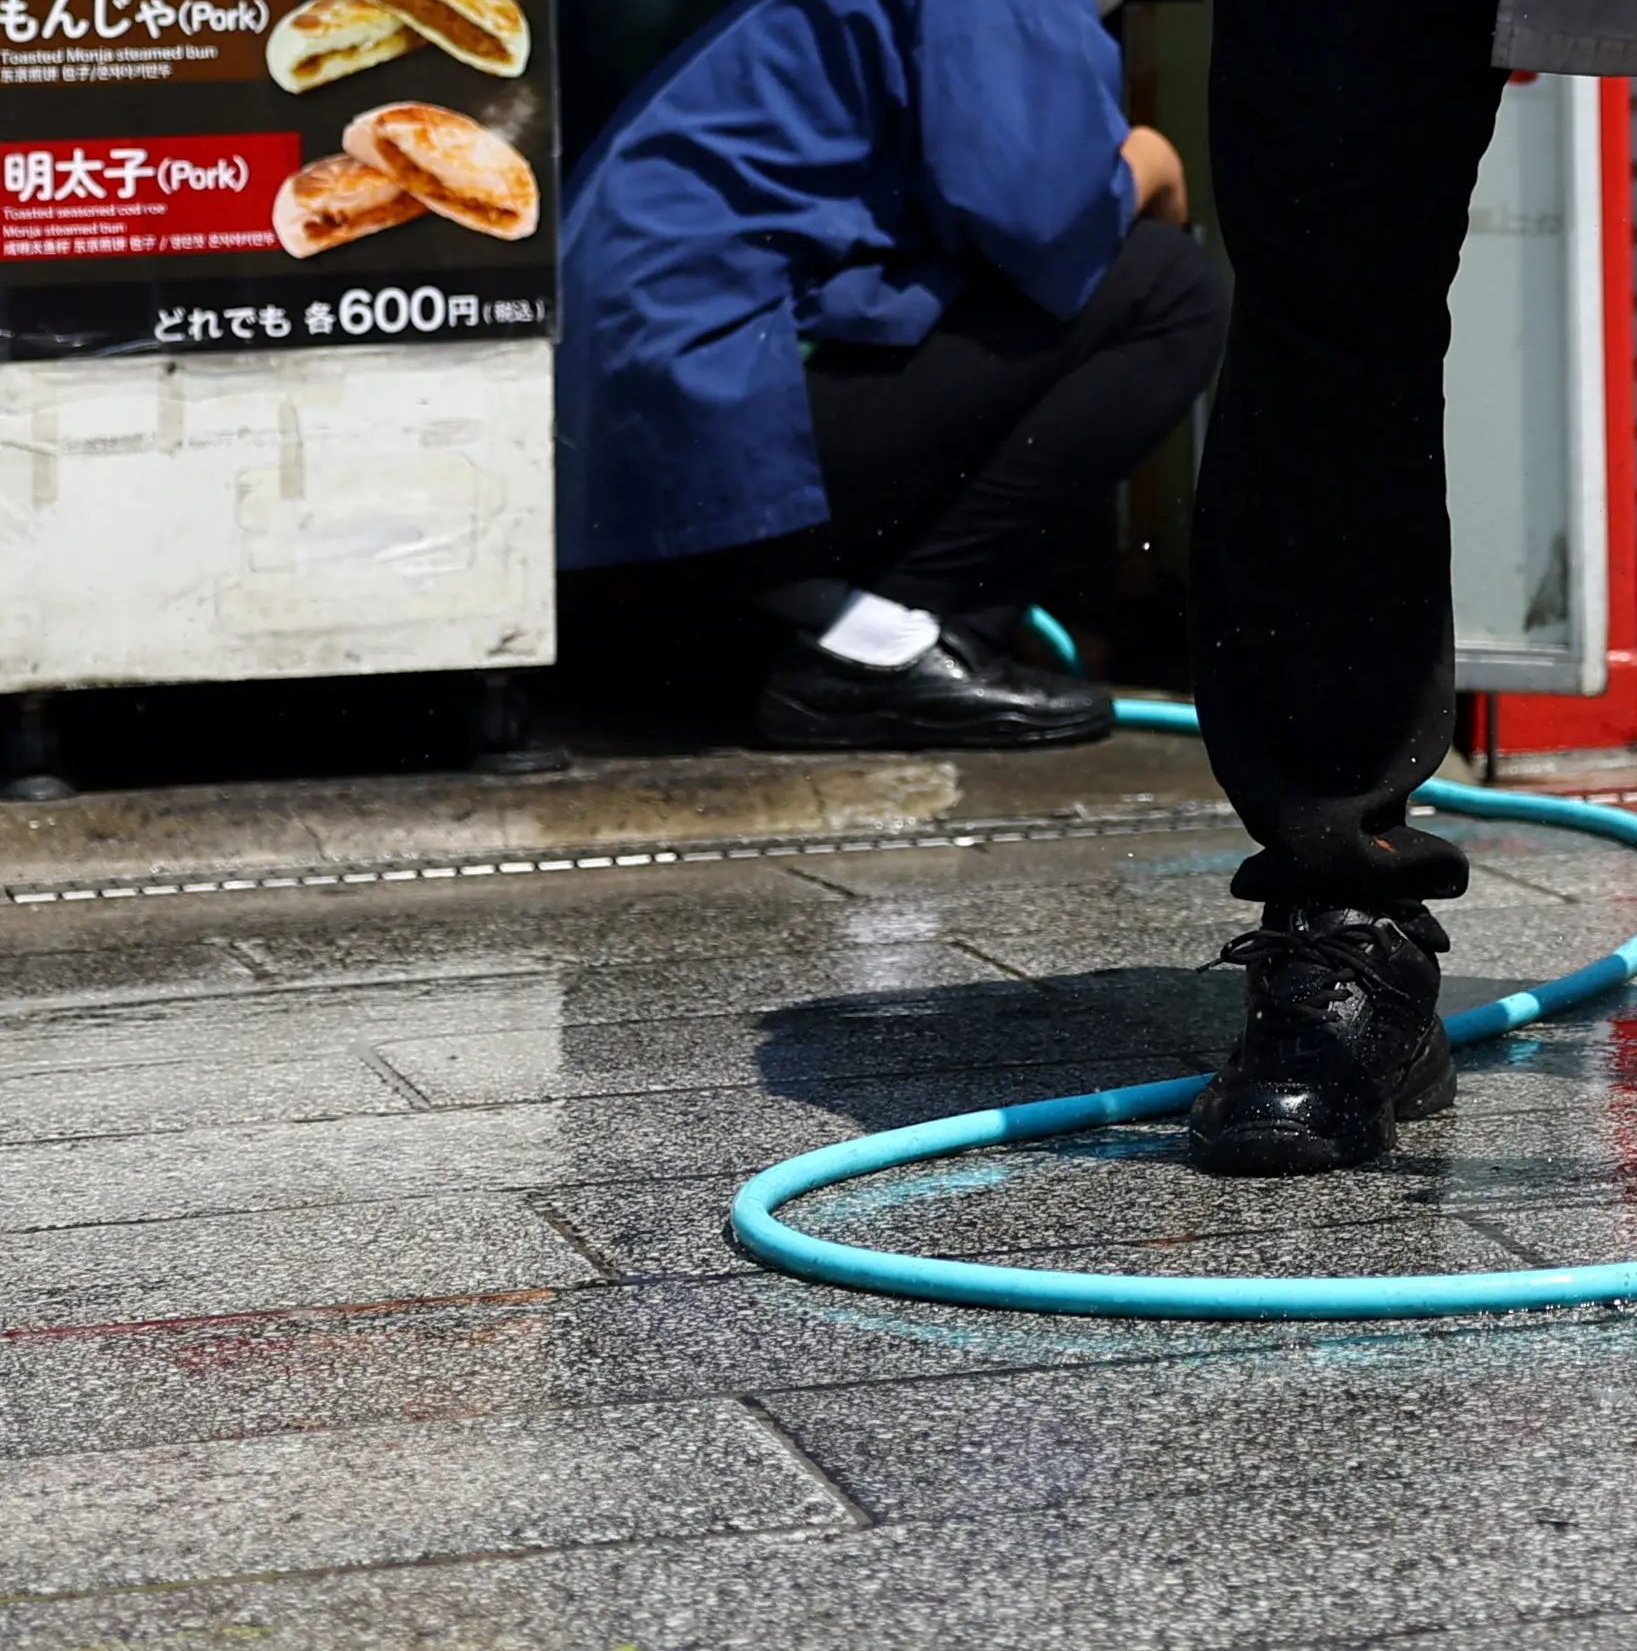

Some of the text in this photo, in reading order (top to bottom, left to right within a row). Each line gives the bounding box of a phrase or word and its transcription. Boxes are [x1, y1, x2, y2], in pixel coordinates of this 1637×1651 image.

[1, 48, 63, 66] Toasted
[65, 47, 113, 66] Monja
[115, 45, 183, 63] steamed
[4, 147, 250, 202] 明太子(Pork)
[3, 206, 55, 221] Toasted
[57, 205, 115, 220] seasoned
[117, 203, 142, 218] cod
[3, 225, 42, 240] Monja
[43, 223, 98, 238] steamed
[153, 303, 294, 343] どれでも
